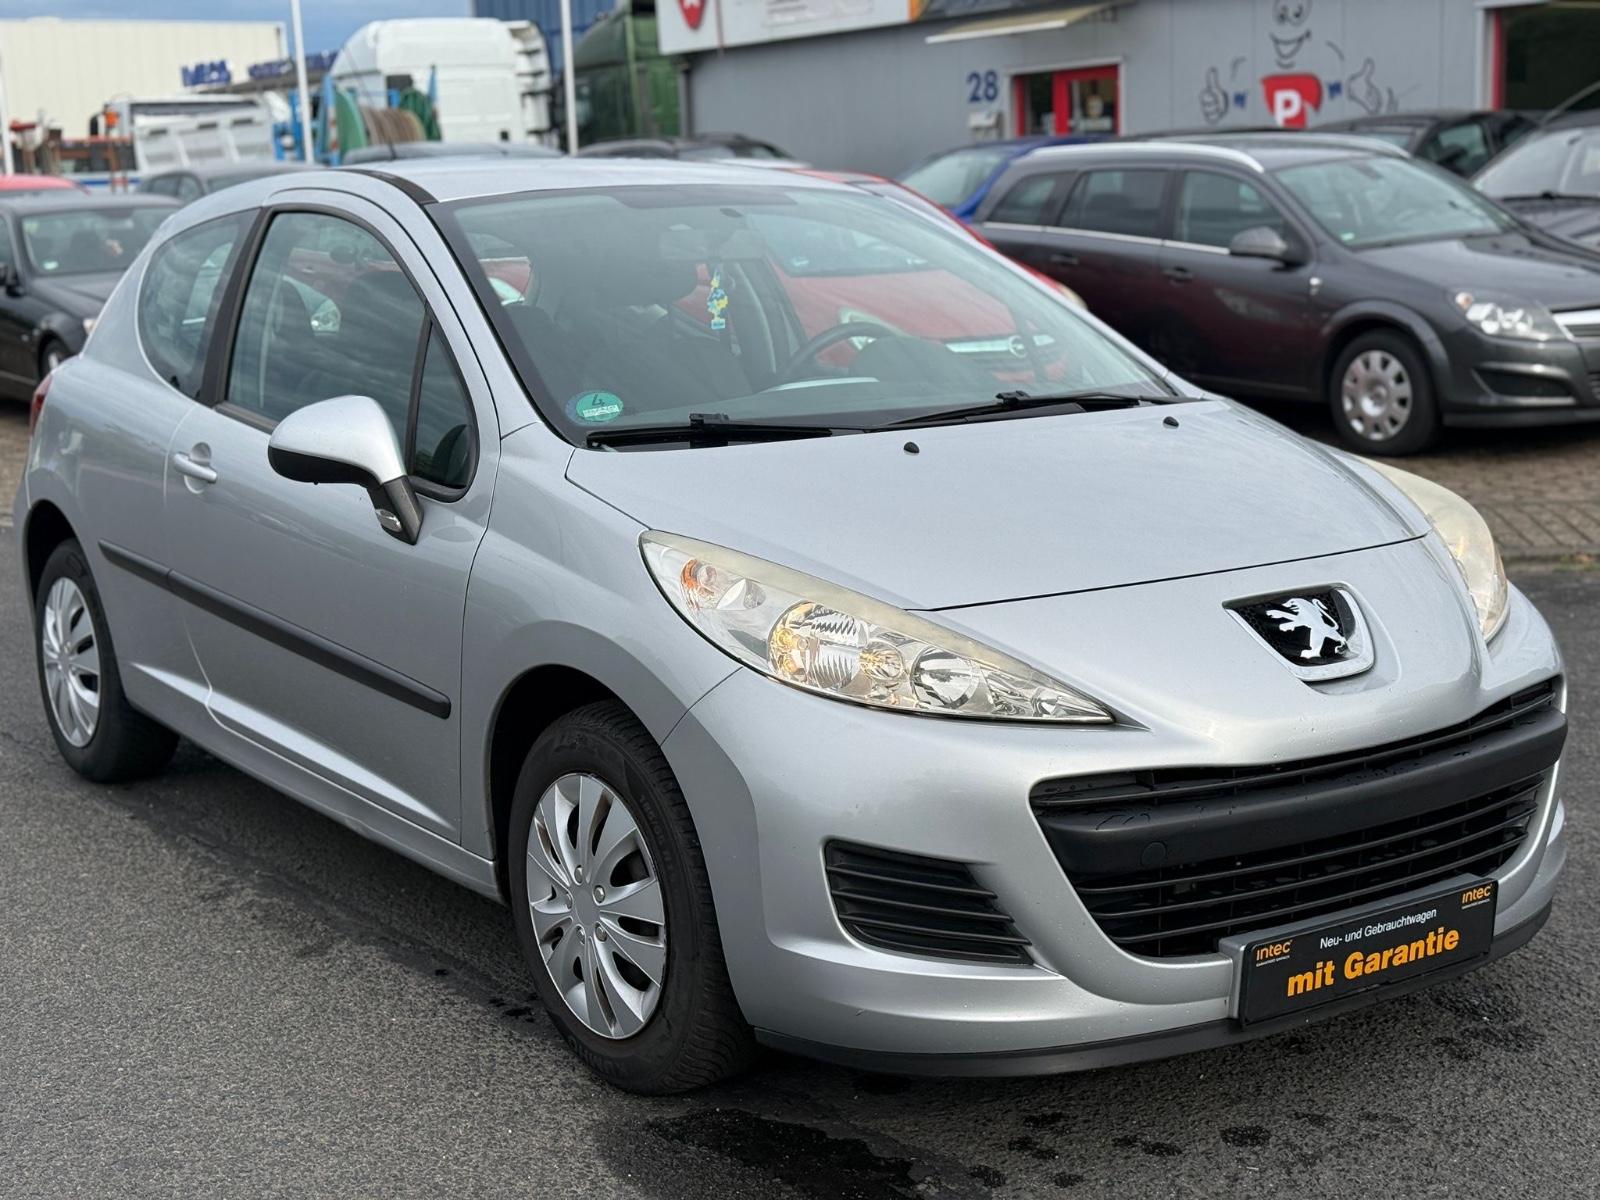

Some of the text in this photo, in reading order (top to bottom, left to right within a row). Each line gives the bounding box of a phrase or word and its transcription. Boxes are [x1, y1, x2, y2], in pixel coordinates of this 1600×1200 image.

[966, 69, 998, 103] 28
[1274, 89, 1302, 128] P
[1319, 909, 1437, 949] Neu- und Gebrauchtwagen
[1287, 926, 1460, 997] mit Garantie
